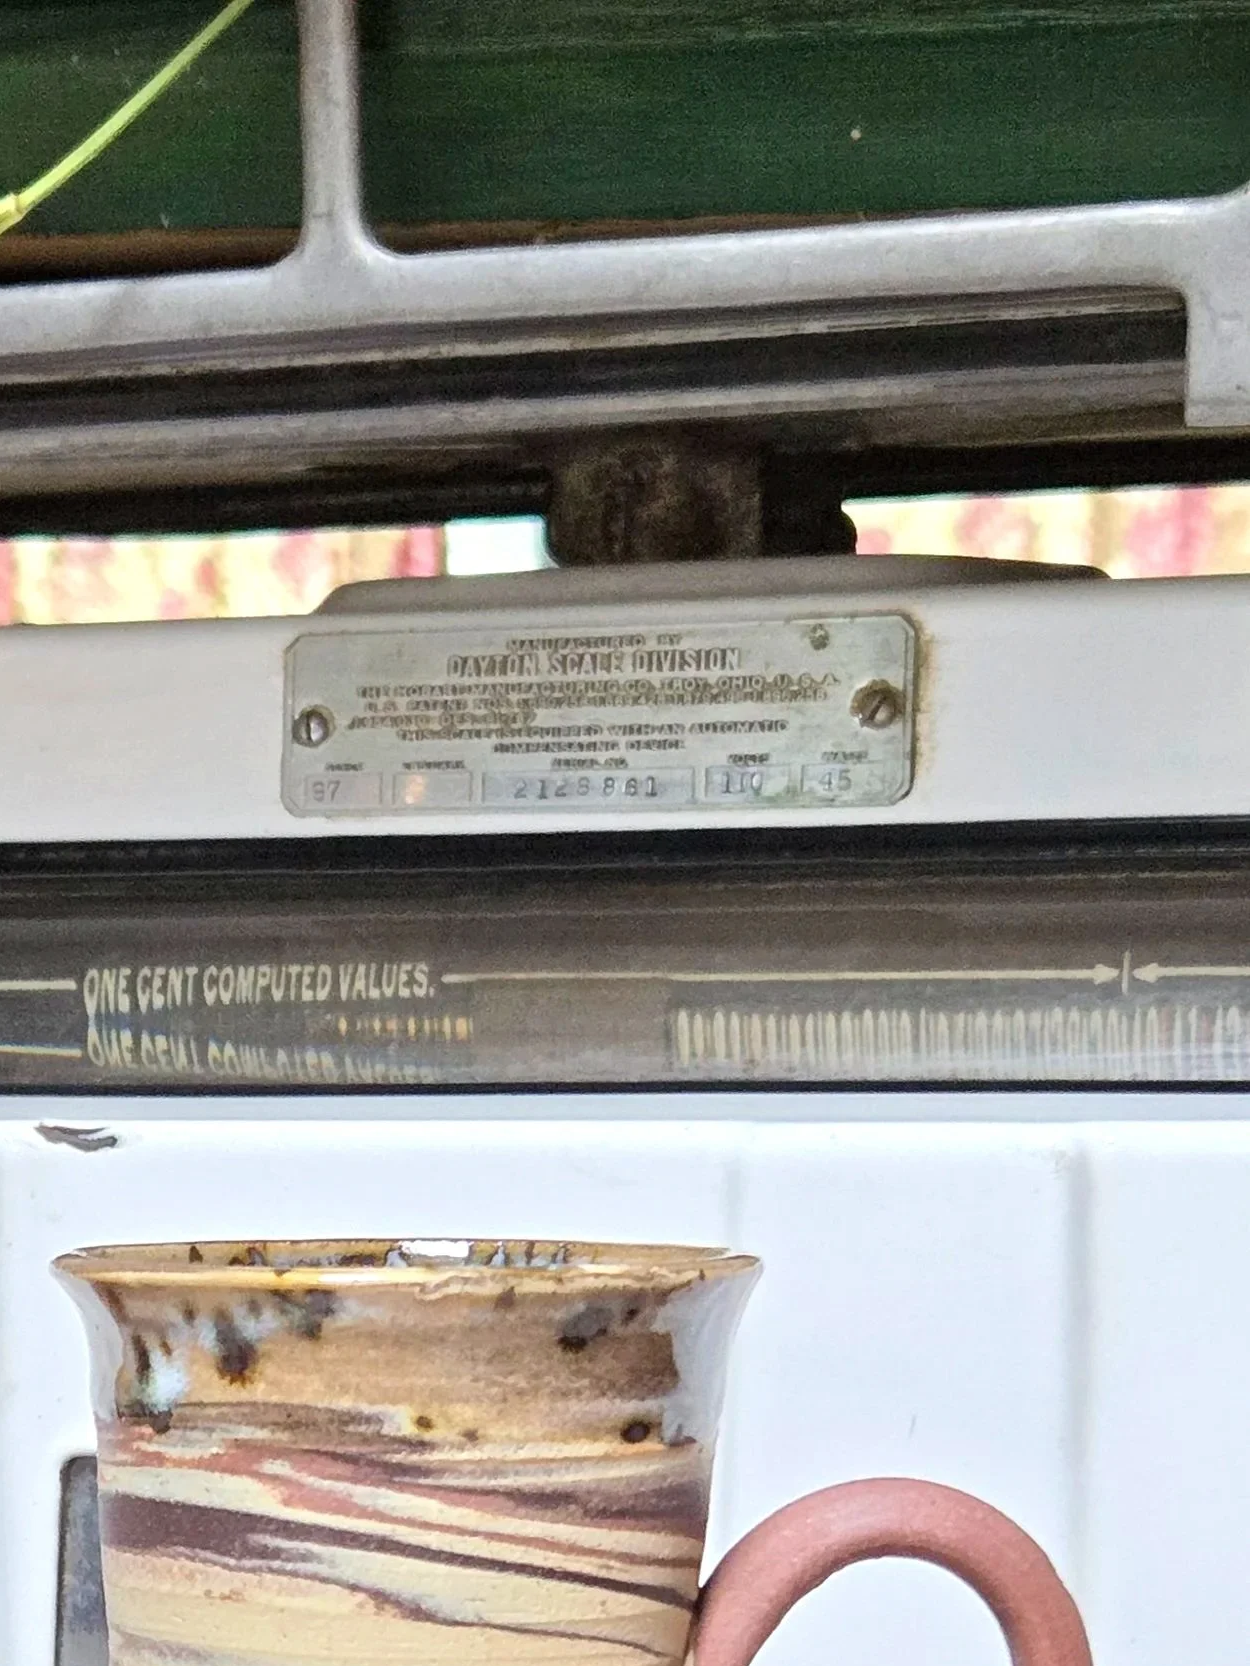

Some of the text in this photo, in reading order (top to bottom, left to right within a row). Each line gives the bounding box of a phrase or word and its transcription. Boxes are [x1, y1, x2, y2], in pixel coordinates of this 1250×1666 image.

[506, 635, 646, 652] MANUFACTURED
[447, 647, 740, 677] DAYTON SCALE DIVISION
[468, 679, 620, 697] MANUFACTURING
[689, 719, 789, 736] AUTOMATIC
[83, 967, 132, 1015] ONE
[136, 966, 199, 1014] CENT
[203, 964, 333, 1007] COMPUTED
